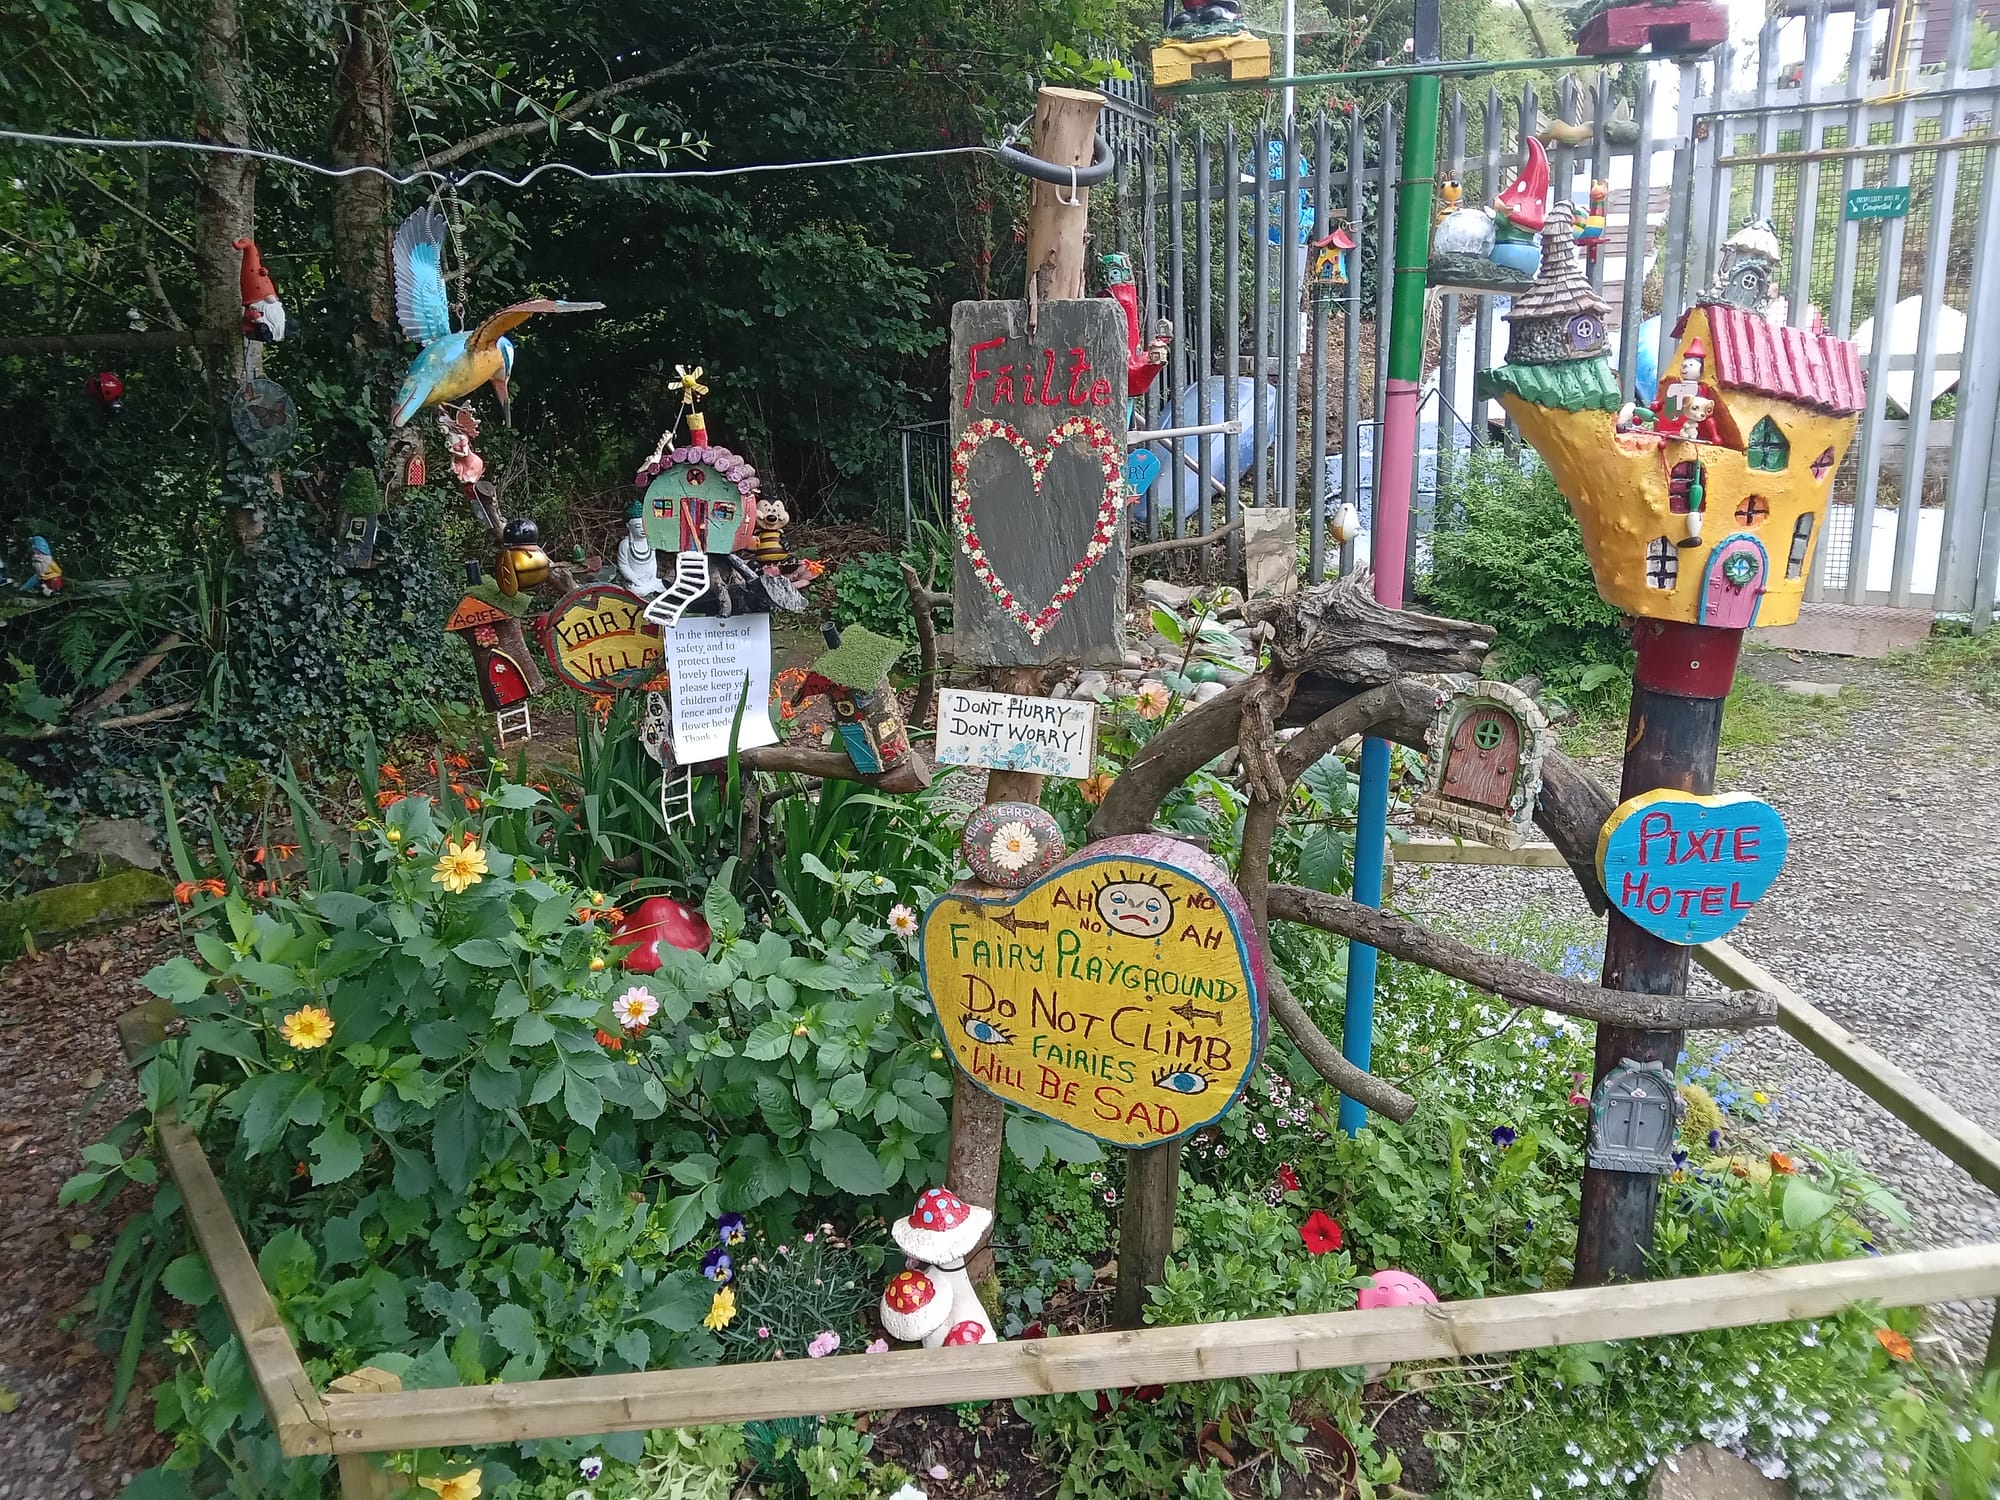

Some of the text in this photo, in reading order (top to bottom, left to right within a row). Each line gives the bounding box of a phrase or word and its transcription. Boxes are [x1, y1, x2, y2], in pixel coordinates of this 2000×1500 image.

[453, 609, 503, 628] AOIFE
[554, 606, 643, 648] FAIRY
[675, 626, 751, 640] In the interest of
[706, 641, 723, 651] and
[677, 654, 736, 668] protect these
[678, 668, 707, 680] lovely
[680, 680, 754, 695] please keep yor
[680, 695, 717, 705] children
[720, 693, 733, 702] off
[681, 709, 705, 718] fence
[707, 706, 723, 715] and
[1007, 698, 1072, 727] HURRY
[682, 721, 710, 731] flower
[998, 806, 1038, 822] CAROL
[963, 813, 991, 845] HELEN
[1638, 811, 1761, 866] PIXIE
[967, 853, 1000, 881] NUALA
[1052, 886, 1095, 912] AH
[1186, 892, 1216, 911] NO
[1621, 871, 1755, 918] HOTEL
[1079, 917, 1102, 933] NO
[1179, 925, 1223, 950] AH
[1056, 929, 1238, 1004] PLAYGROUND
[1031, 988, 1105, 1039] NOT
[1037, 1064, 1080, 1106] BE
[1093, 1086, 1180, 1135] SAD
